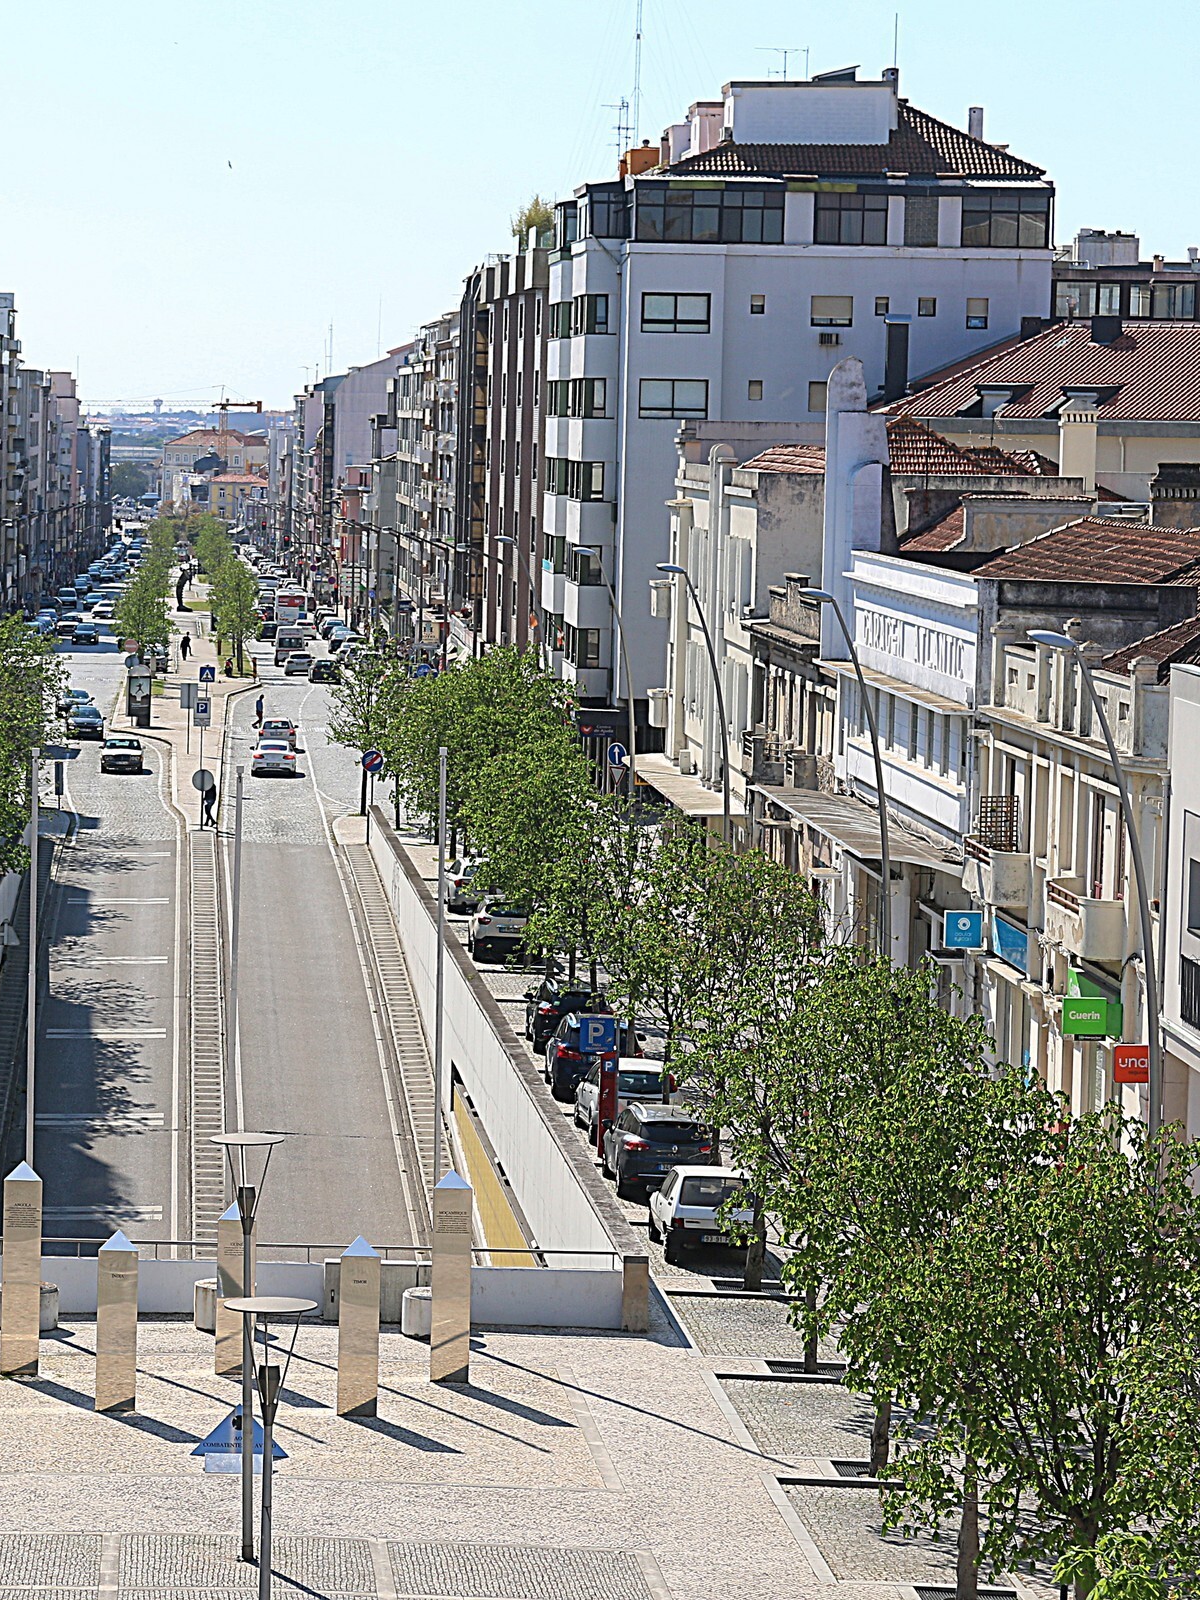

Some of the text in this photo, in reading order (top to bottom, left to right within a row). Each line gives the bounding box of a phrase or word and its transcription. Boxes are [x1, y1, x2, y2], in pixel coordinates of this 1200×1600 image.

[862, 609, 905, 660] GARAGEM
[198, 704, 206, 712] P
[1069, 1010, 1101, 1020] Guerin
[588, 1023, 605, 1044] P
[605, 1061, 613, 1071] P
[1119, 1057, 1148, 1068] una
